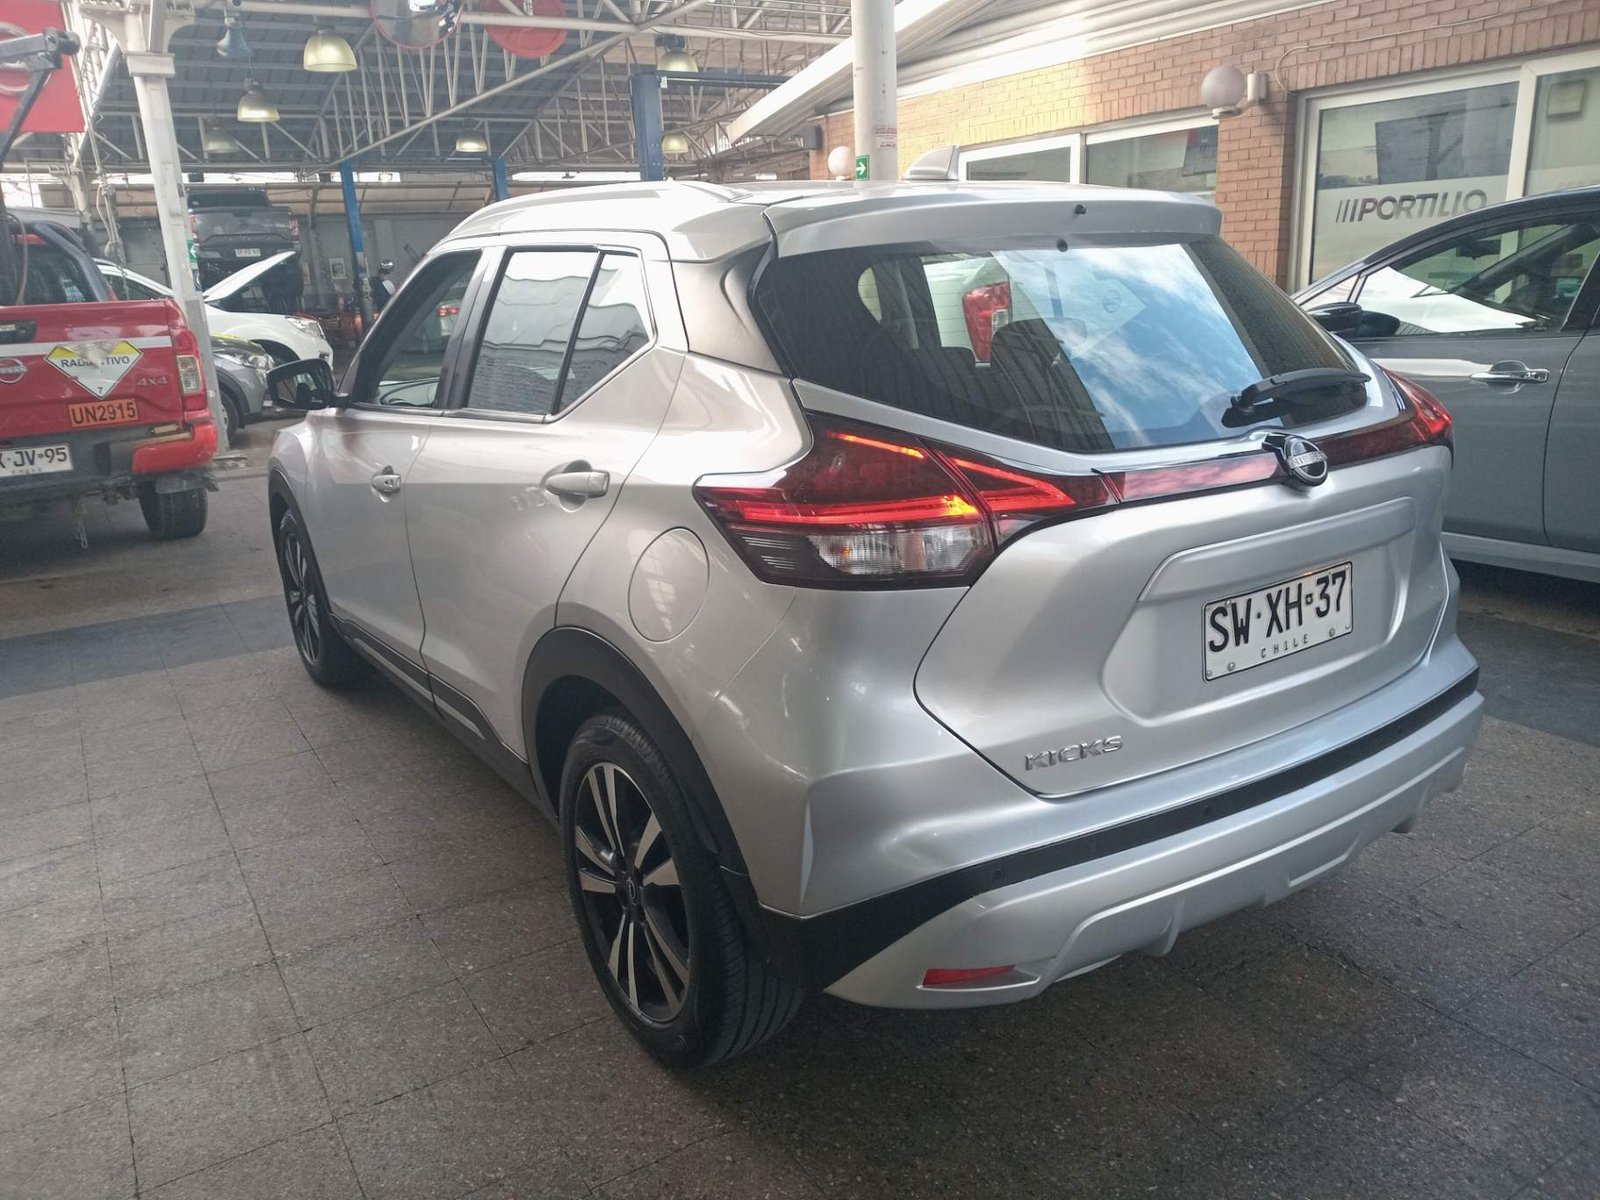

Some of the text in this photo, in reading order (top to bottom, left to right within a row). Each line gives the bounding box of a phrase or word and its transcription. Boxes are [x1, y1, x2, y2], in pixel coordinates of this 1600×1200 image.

[71, 402, 136, 424] UN2915
[1261, 633, 1309, 658] CHILE
[1025, 736, 1122, 771] KICKS
